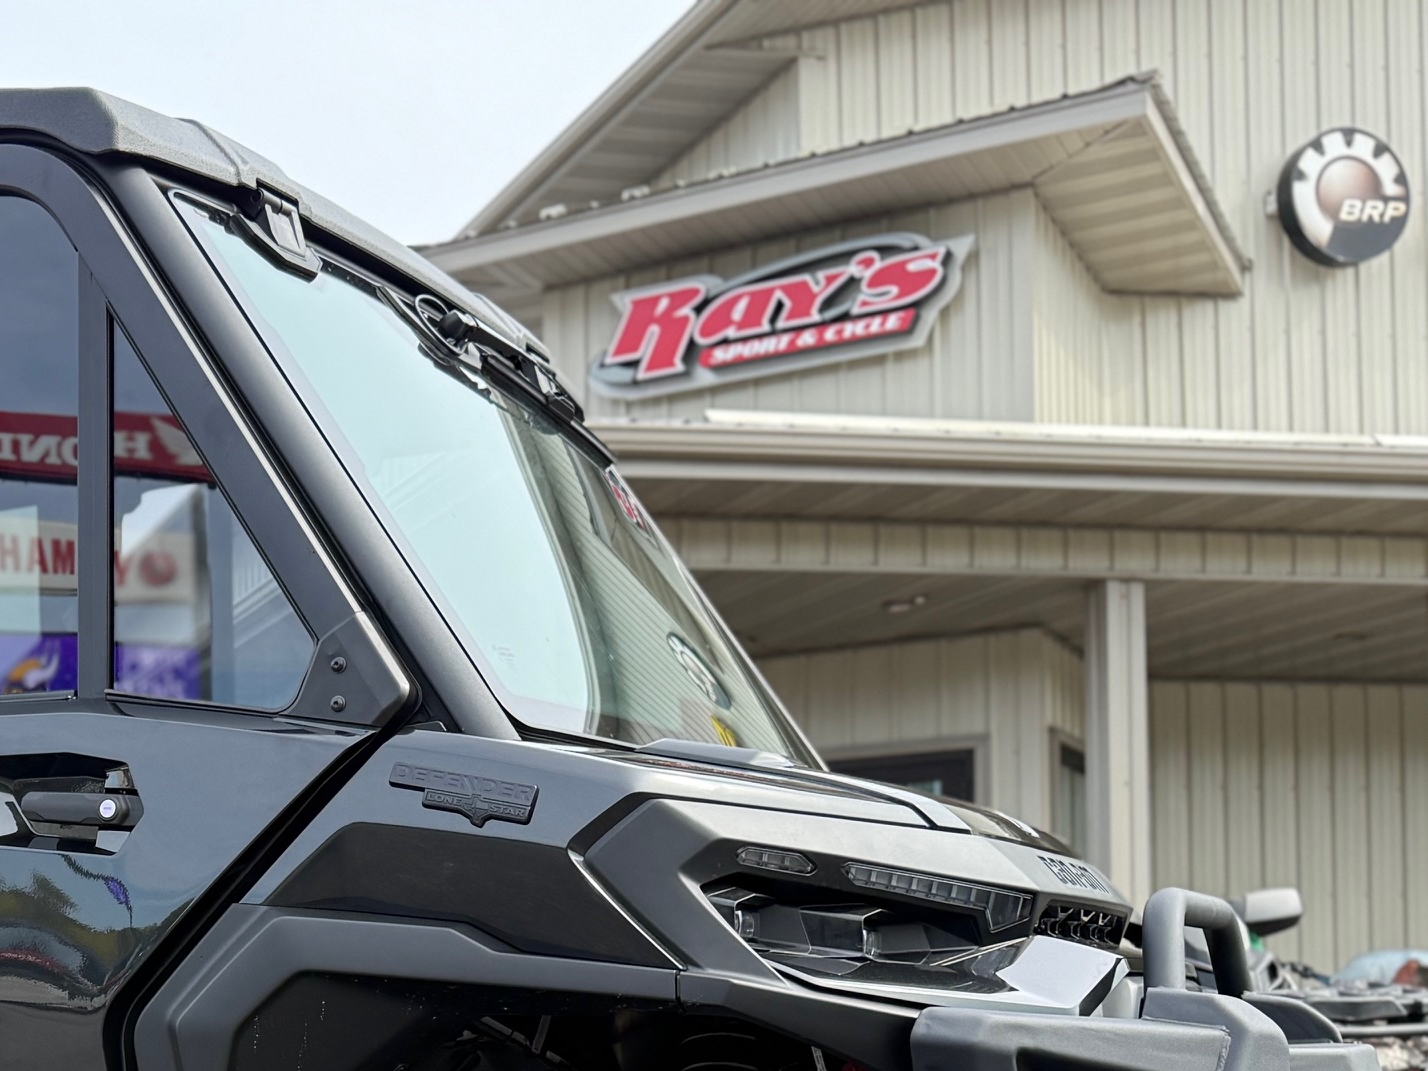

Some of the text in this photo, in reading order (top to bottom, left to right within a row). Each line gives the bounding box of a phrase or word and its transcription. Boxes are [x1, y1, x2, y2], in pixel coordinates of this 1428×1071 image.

[1339, 199, 1407, 223] BRP
[710, 313, 906, 364] SPORT & CYCLE
[394, 763, 532, 801] DEFENDER
[427, 793, 525, 817] LONE STAR
